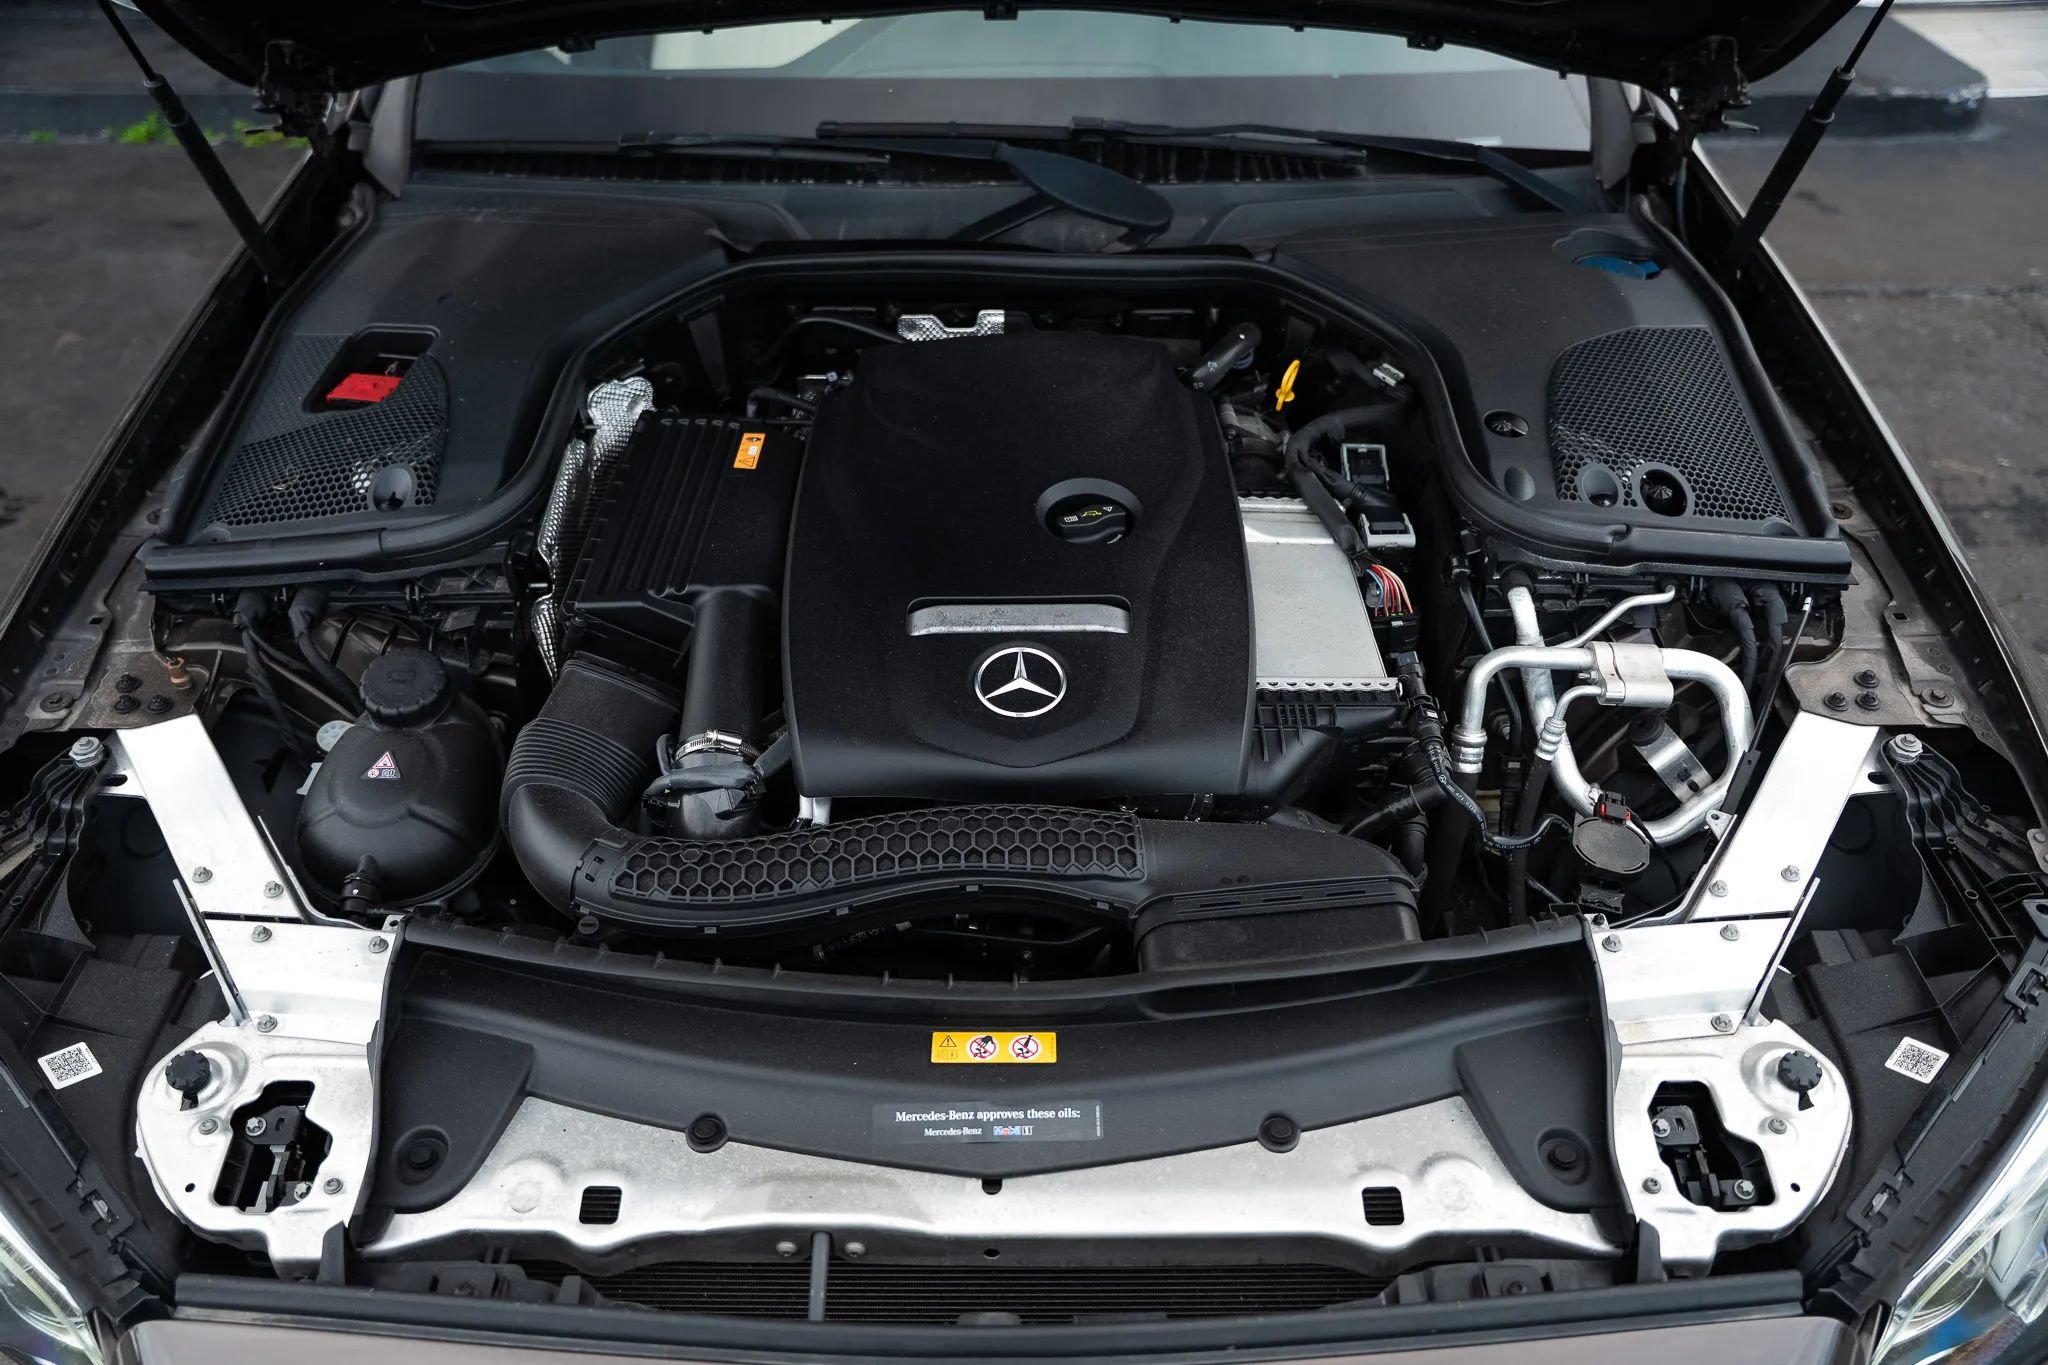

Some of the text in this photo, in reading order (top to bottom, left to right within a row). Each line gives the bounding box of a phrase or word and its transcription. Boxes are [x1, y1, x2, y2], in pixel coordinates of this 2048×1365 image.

[895, 1107, 1081, 1122] Mercedes-Benz approves these oils:
[924, 1126, 983, 1137] Mercedes-Benz
[993, 1125, 1021, 1137] Mobil
